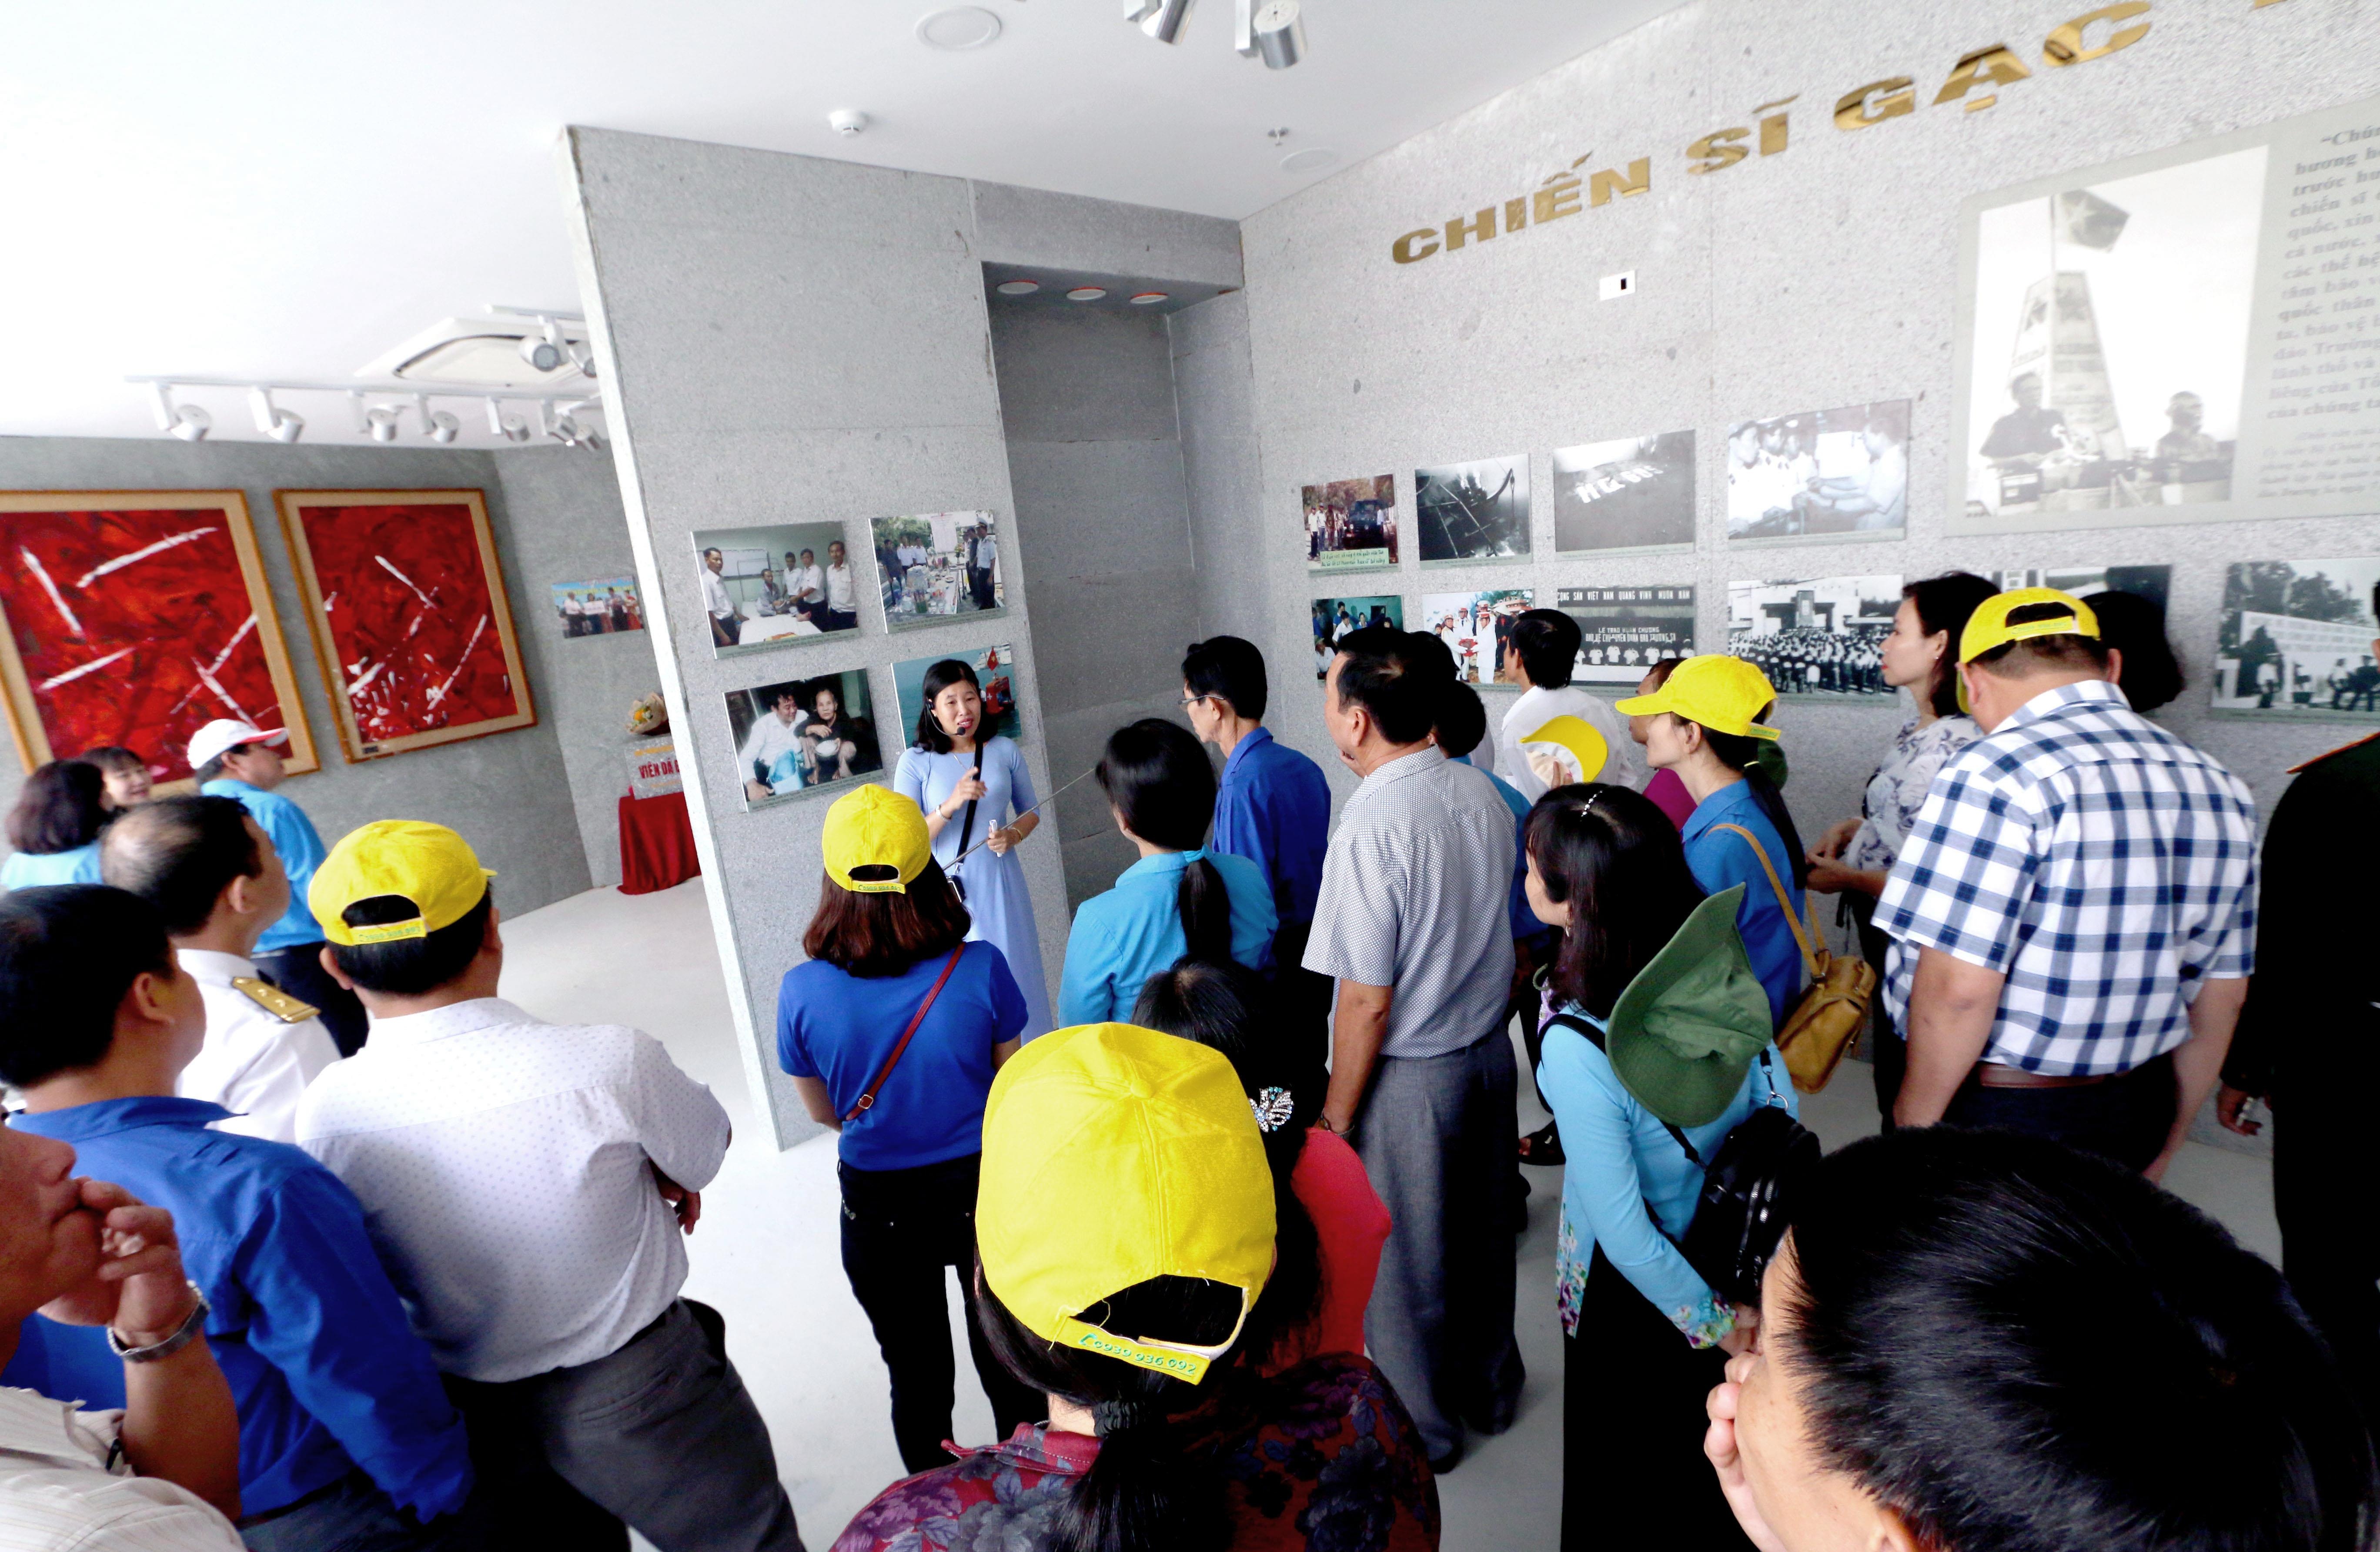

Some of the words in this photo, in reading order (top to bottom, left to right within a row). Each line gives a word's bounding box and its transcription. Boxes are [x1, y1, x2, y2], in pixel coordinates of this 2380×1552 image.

[1392, 150, 1650, 264] CHIẾN
[1685, 94, 1800, 175] SĨ
[1833, 1, 2152, 130] GẠC
[638, 761, 660, 779] VIÊN
[1093, 1340, 1132, 1357] 0939
[1135, 1353, 1164, 1366] 936
[1167, 1358, 1197, 1375] 092
